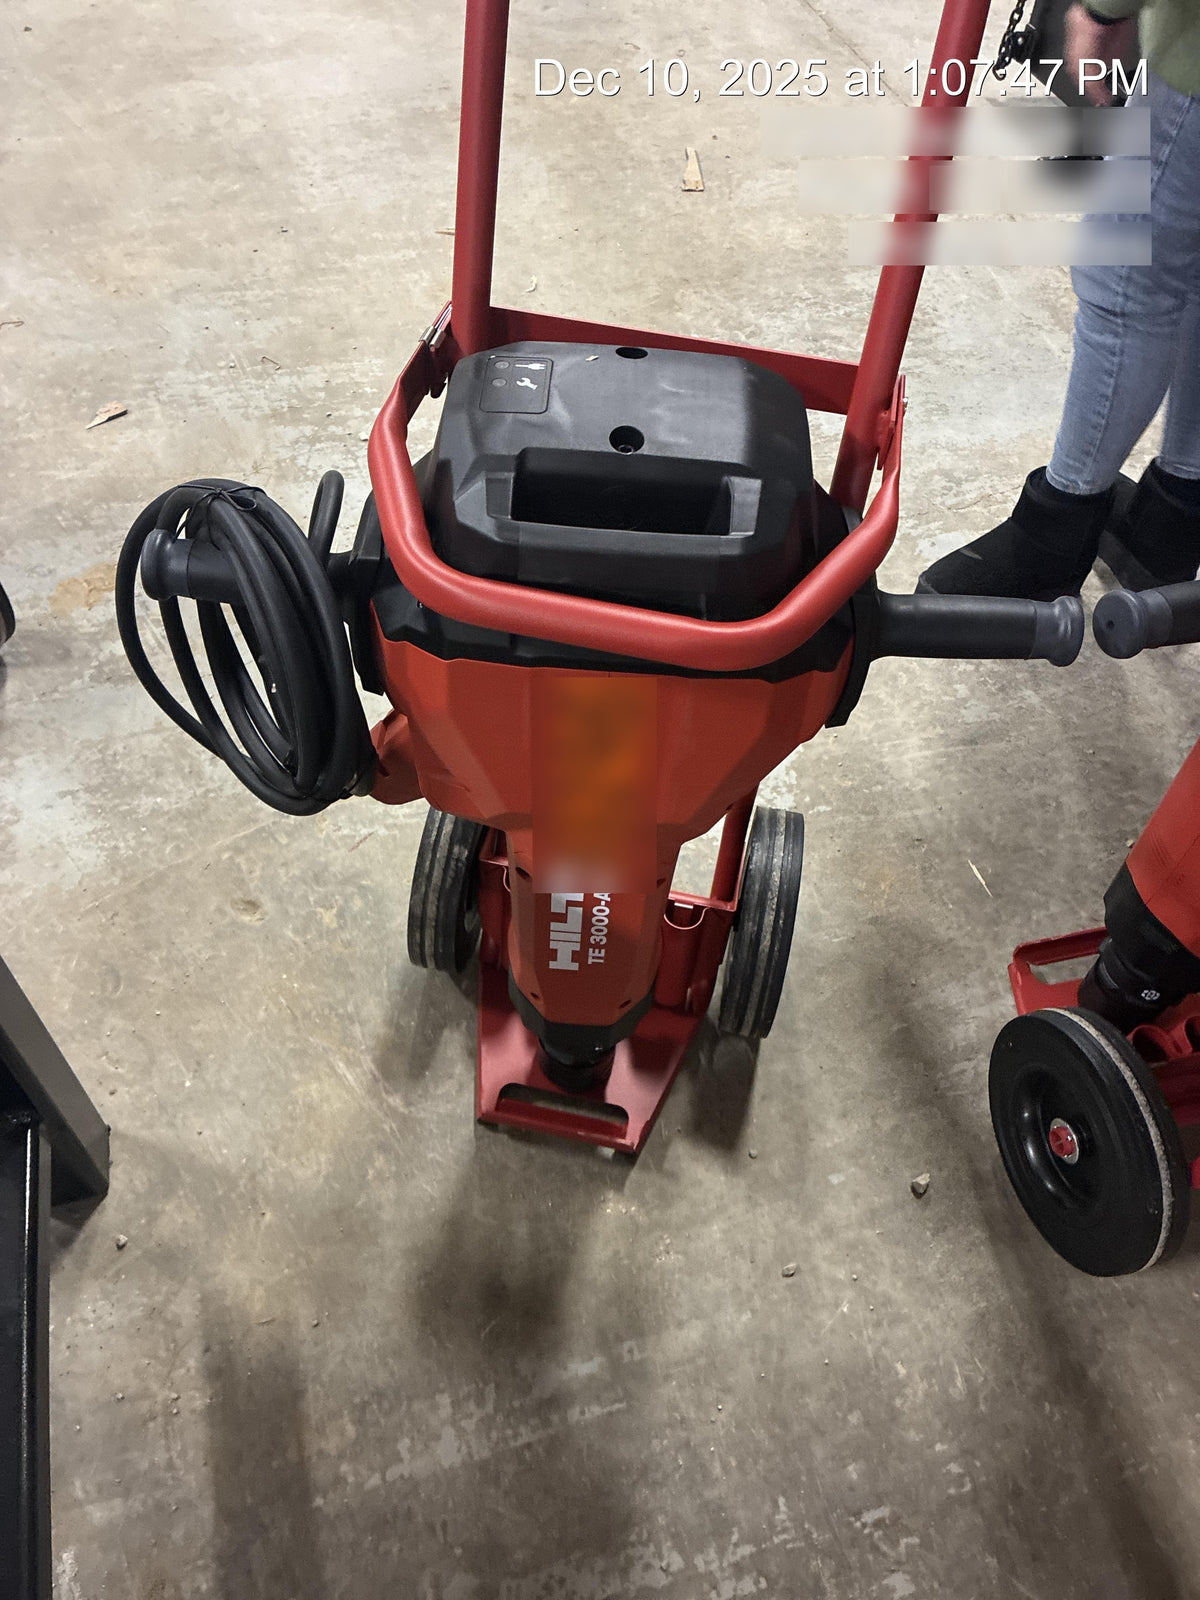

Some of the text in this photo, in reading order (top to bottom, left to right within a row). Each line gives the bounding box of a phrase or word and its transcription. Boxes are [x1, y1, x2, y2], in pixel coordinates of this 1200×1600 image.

[549, 892, 585, 971] HILT
[587, 892, 611, 965] TE 3000-A
